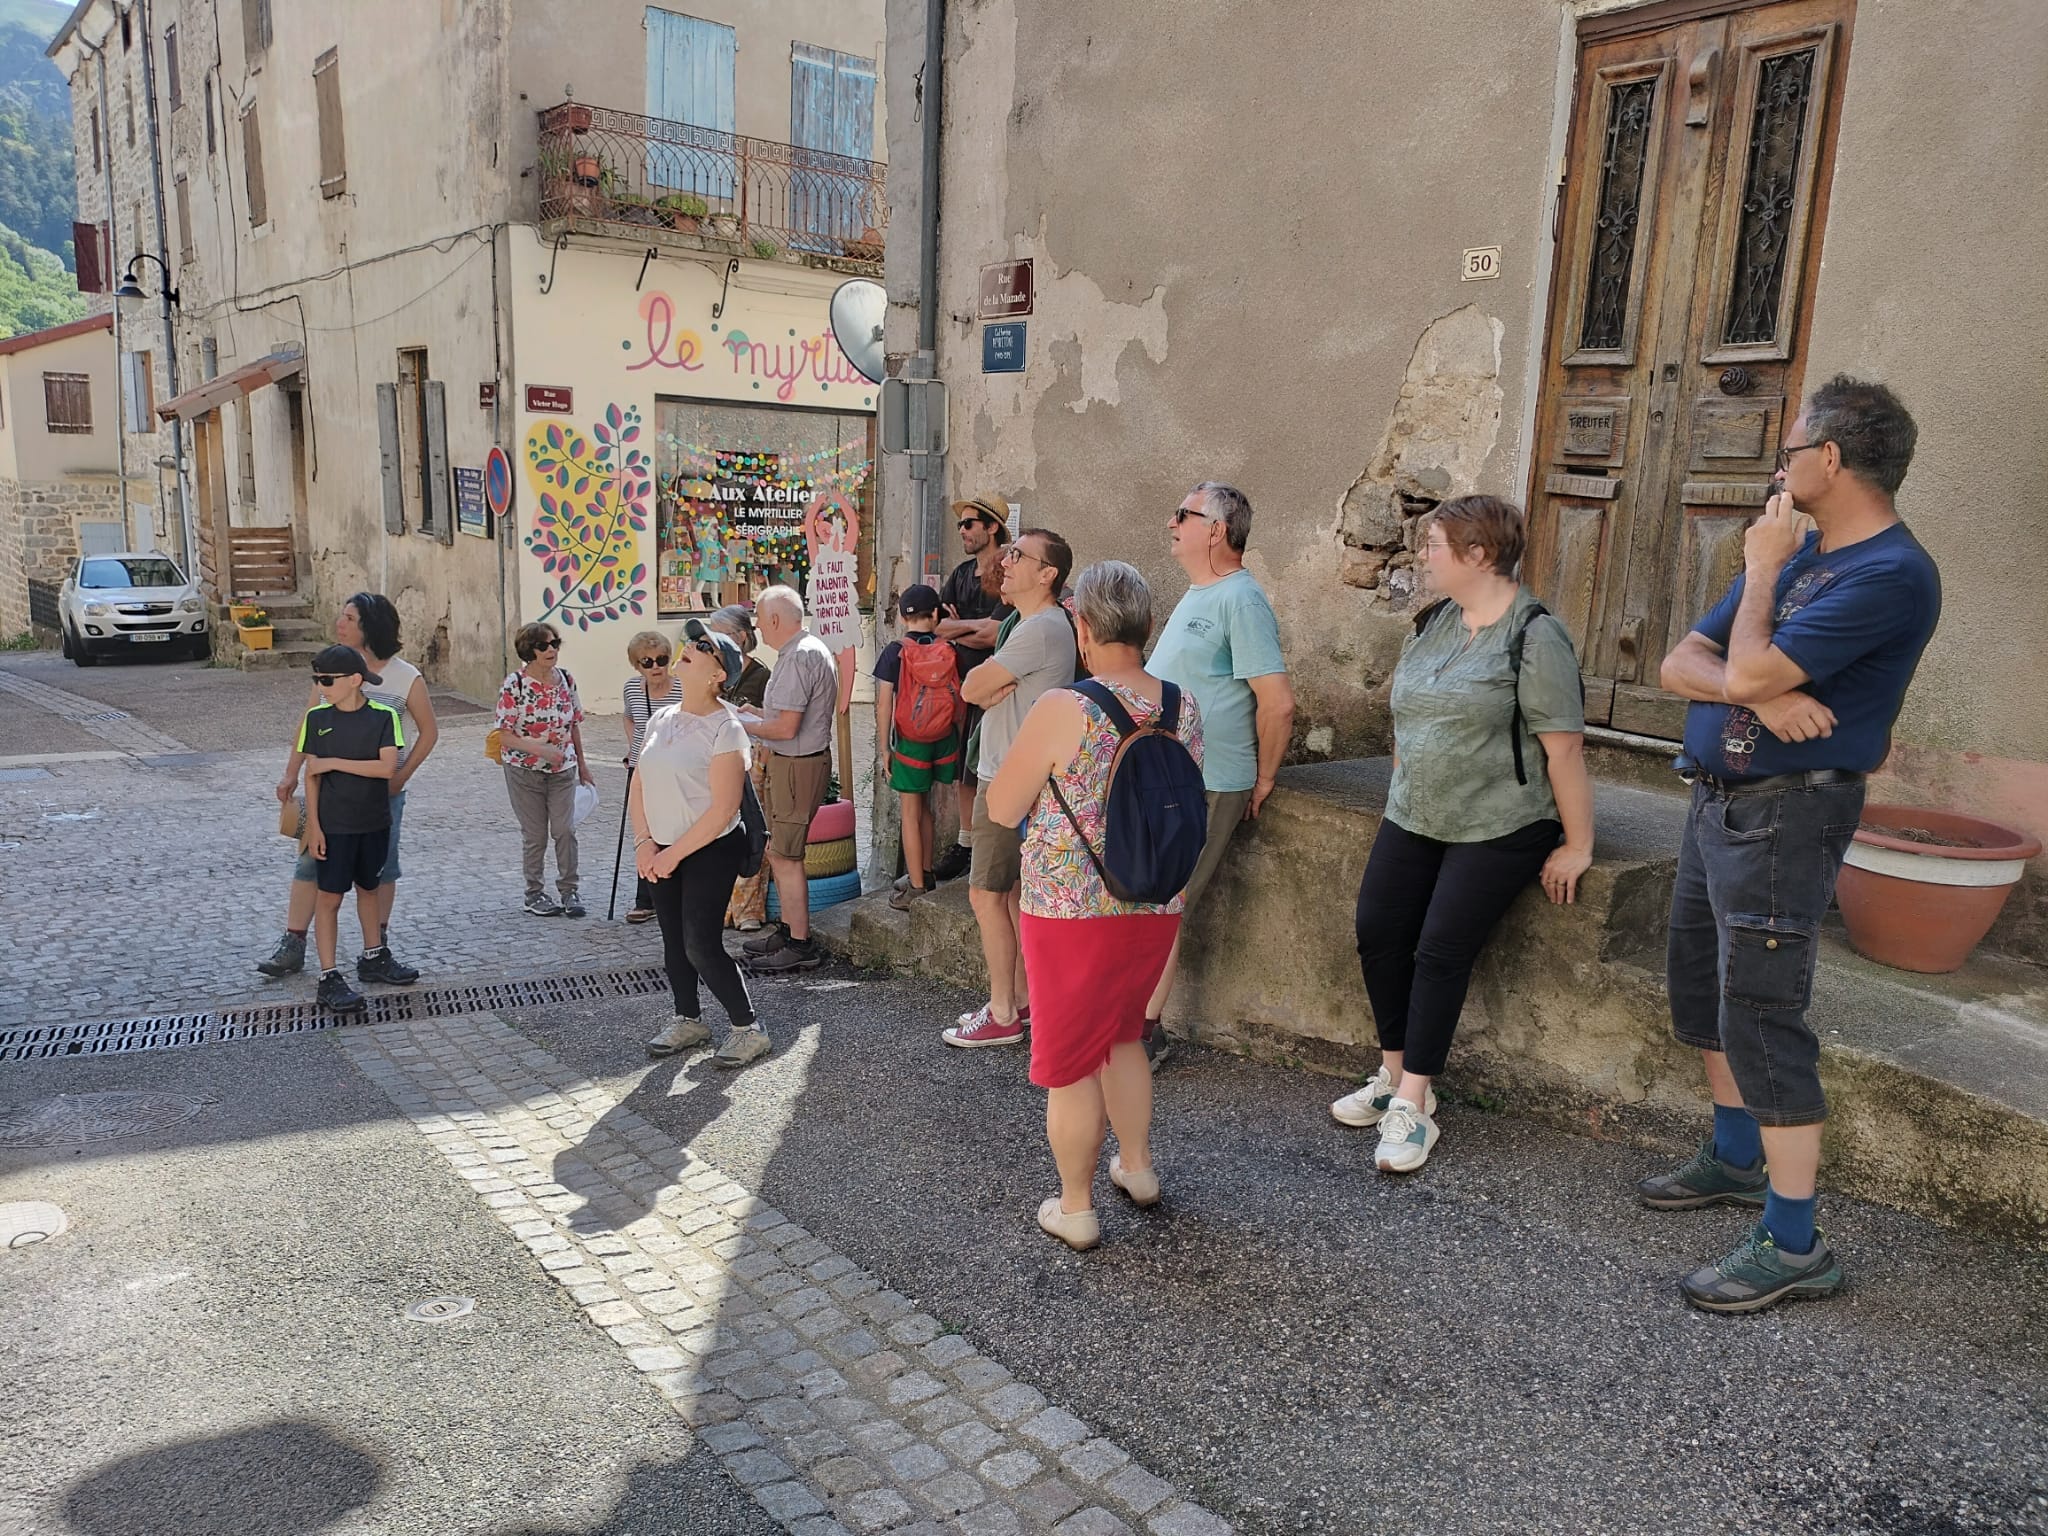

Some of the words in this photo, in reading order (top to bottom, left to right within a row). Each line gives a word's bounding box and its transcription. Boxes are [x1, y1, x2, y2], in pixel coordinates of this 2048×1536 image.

[1470, 254, 1491, 272] 50
[998, 272, 1011, 284] Rue
[983, 295, 992, 305] de
[992, 294, 999, 305] la
[626, 296, 704, 371] le
[543, 390, 556, 398] Rue
[532, 399, 551, 407] Victor
[551, 401, 568, 410] Hugo
[709, 483, 746, 501] Aux
[734, 507, 746, 518] LE
[748, 508, 803, 519] MYRTILLIER
[735, 522, 801, 536] SÉRIGRAPHIE
[827, 561, 844, 574] FAUT
[816, 594, 825, 605] LA
[819, 623, 830, 636] UN
